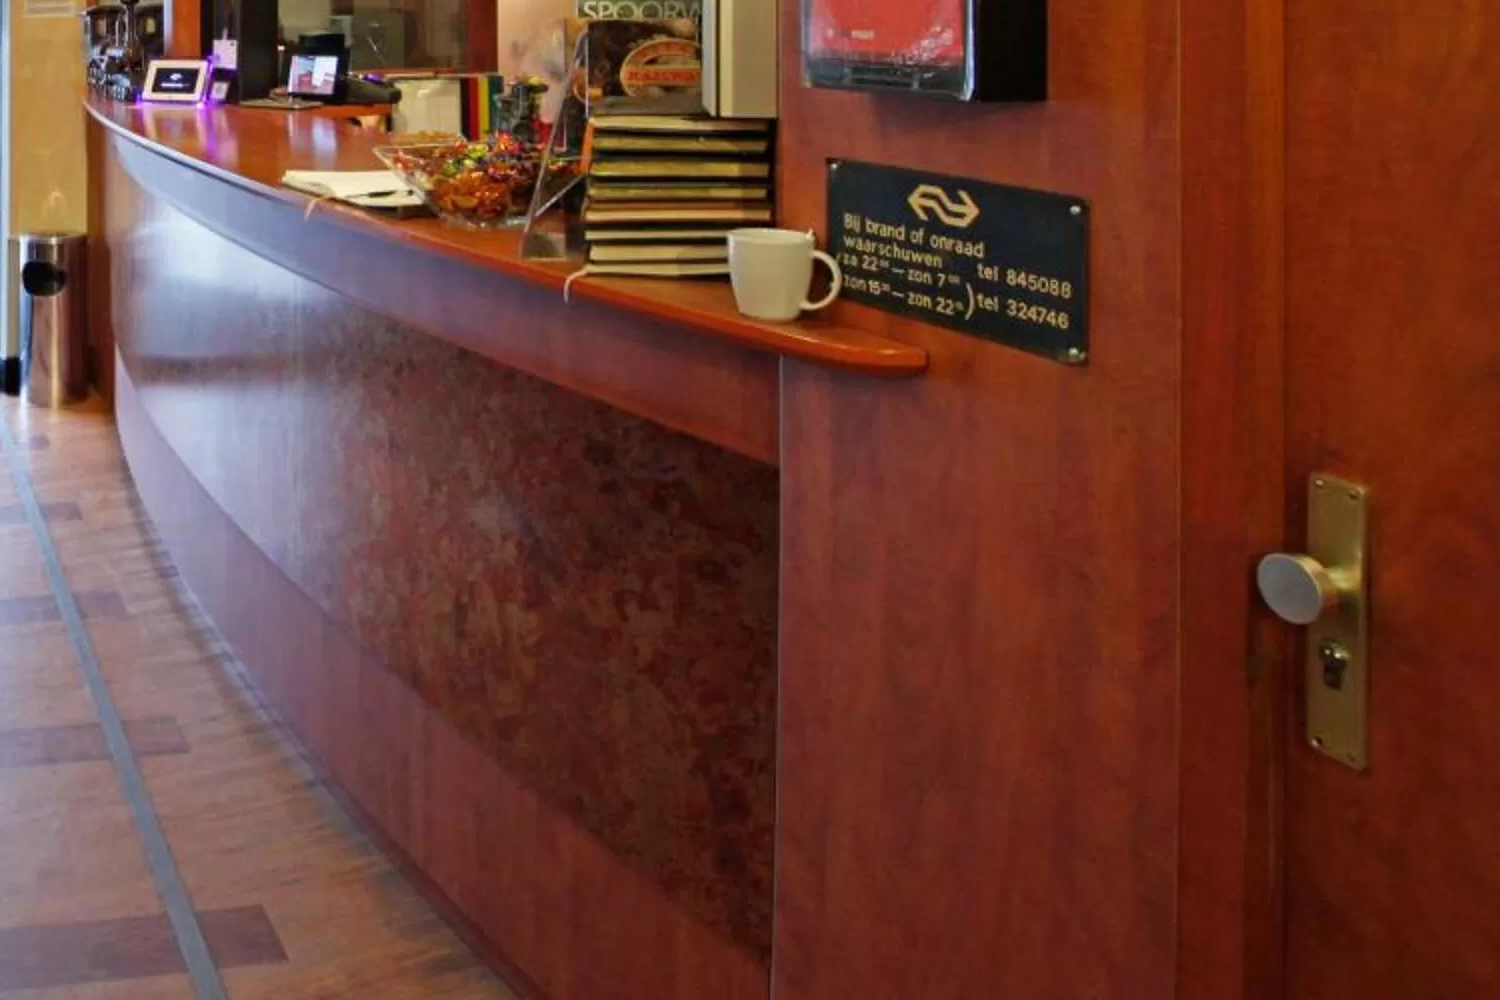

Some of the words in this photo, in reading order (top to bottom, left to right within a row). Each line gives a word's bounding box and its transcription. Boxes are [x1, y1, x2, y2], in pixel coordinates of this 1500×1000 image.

[843, 211, 861, 234] Bij
[864, 217, 906, 241] brand
[909, 227, 925, 246] of
[929, 234, 985, 259] onraad
[843, 235, 943, 269] waarschuwen
[907, 268, 933, 285] zon
[976, 262, 999, 282] tel
[1005, 267, 1073, 300] 845088
[907, 290, 933, 310] zon
[976, 291, 999, 314] tel
[1005, 298, 1071, 330] 324746
